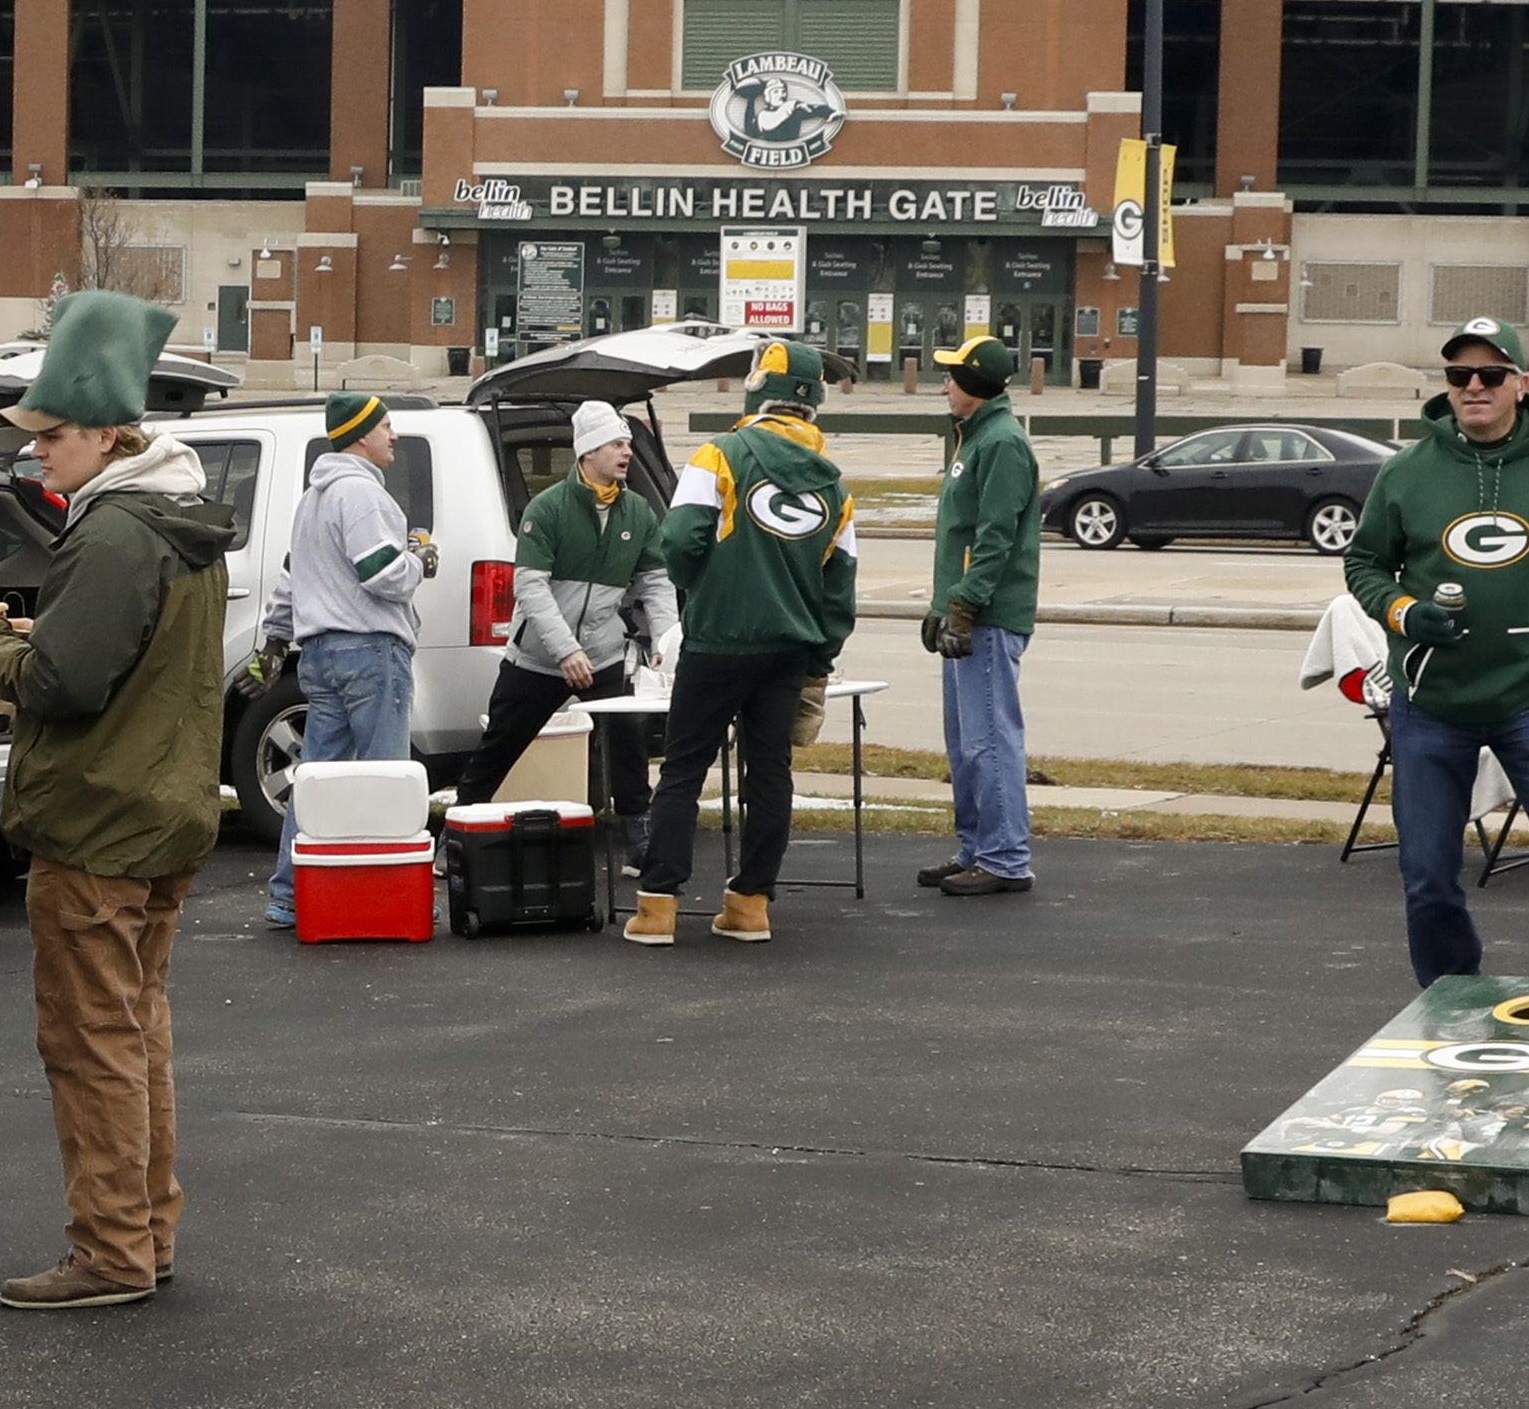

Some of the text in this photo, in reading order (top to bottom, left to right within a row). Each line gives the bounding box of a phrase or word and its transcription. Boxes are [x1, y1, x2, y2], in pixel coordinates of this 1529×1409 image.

[734, 55, 821, 81] LAMBEAU
[748, 147, 803, 166] FIELD
[455, 179, 520, 202] bellin
[1016, 185, 1085, 209] bellin
[550, 186, 998, 221] BELLIN HEALTH GATE
[750, 301, 788, 311] NO BAGS
[748, 314, 790, 324] ALLOWED
[1447, 515, 1529, 564] G
